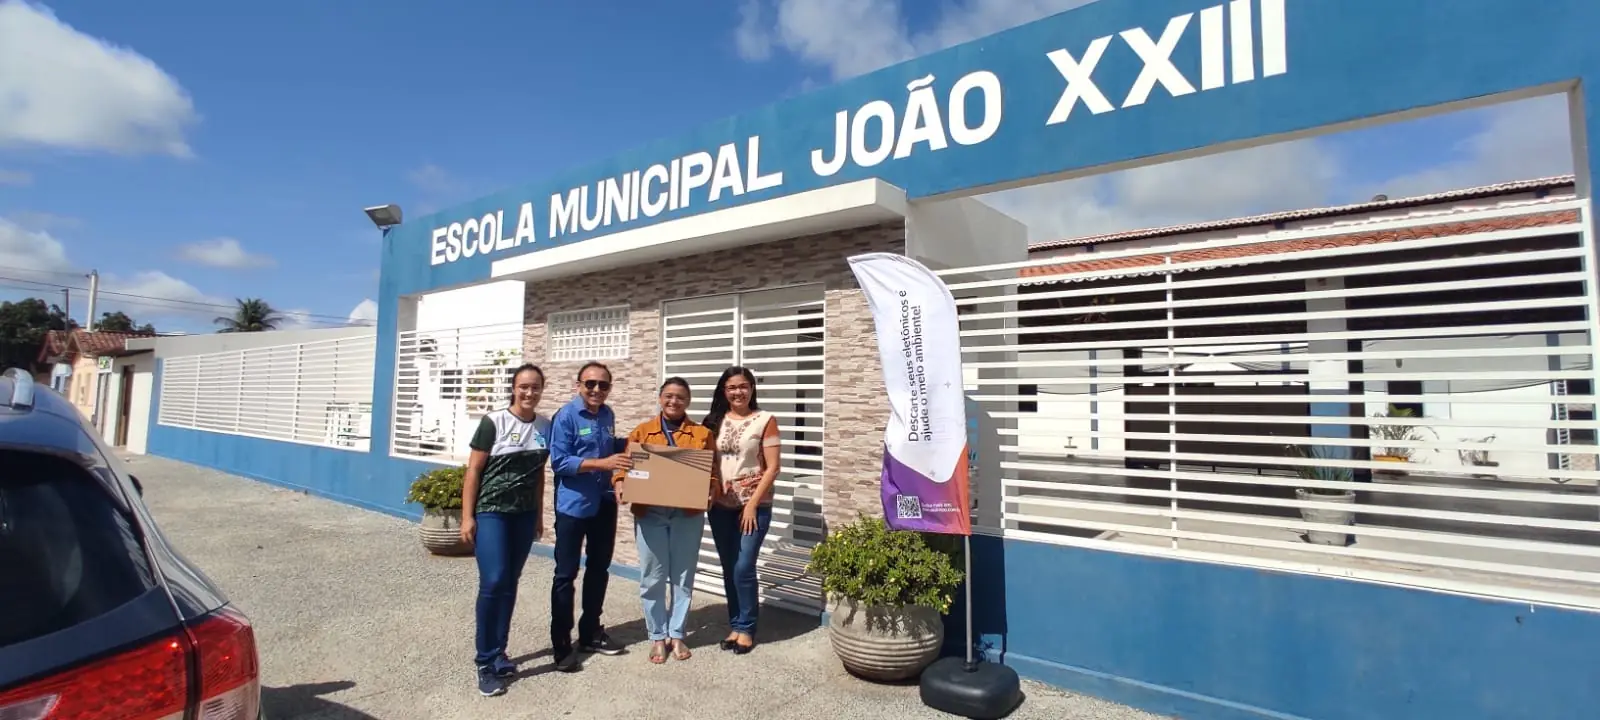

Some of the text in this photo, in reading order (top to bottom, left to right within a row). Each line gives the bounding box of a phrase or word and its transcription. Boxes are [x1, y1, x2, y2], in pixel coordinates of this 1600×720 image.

[431, 0, 1288, 266] ESCOLA MUNICIPAL JOÃO XXIII
[906, 360, 916, 387] seus
[908, 389, 919, 442] Descarte
[910, 305, 933, 441] ajude o meio ambiente!
